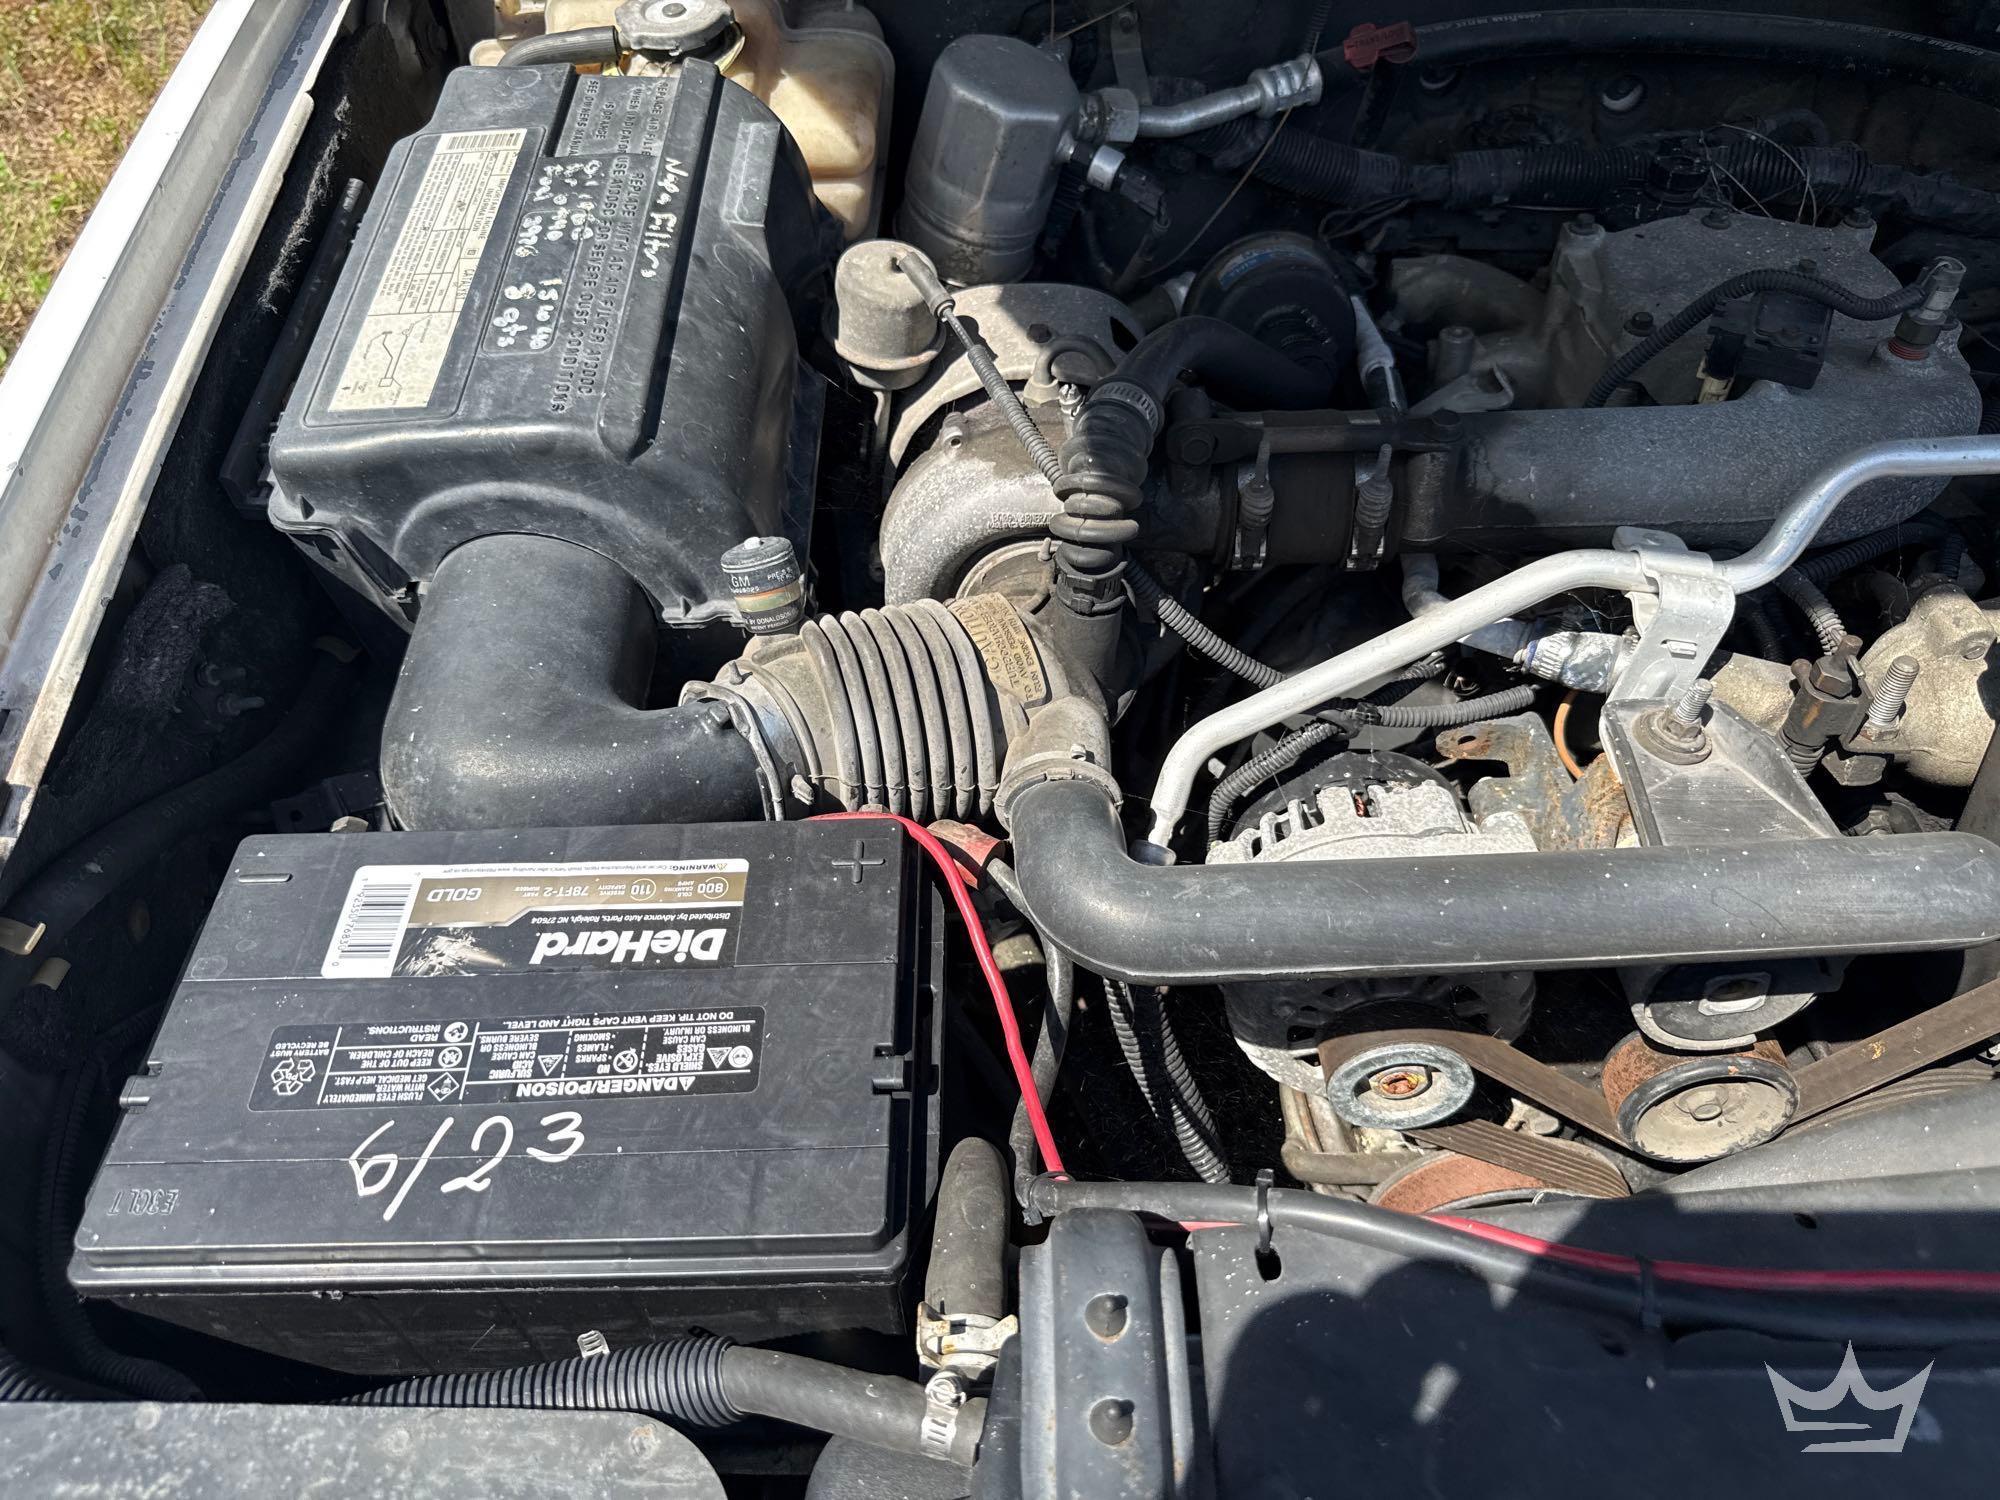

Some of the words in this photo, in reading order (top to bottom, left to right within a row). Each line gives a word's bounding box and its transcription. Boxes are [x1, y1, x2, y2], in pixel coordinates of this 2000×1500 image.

[586, 80, 598, 94] SEE
[626, 88, 643, 110] WHEN
[650, 82, 669, 114] REPLACE
[577, 96, 594, 127] OWNERS
[648, 117, 659, 130] AIR
[612, 157, 630, 176] USE
[487, 178, 507, 215] IMPORTANT
[622, 173, 645, 217] REPLACE
[472, 188, 494, 232] INFORMATION
[477, 216, 494, 240] ENGINE
[595, 220, 612, 241] FOR
[612, 221, 634, 252] WITH
[583, 244, 606, 287] SEVERE
[455, 268, 475, 301] CATALYST
[603, 278, 620, 295] AIR
[571, 294, 594, 325] DUST
[590, 301, 614, 344] FILTER
[549, 331, 585, 412] CONDITIONS
[731, 575, 751, 587] GM
[953, 604, 1000, 670] CAUTION
[1017, 636, 1035, 666] ENGINE
[1013, 652, 1028, 679] AVOID
[1030, 670, 1042, 693] RUN
[1024, 685, 1033, 701] TO
[543, 886, 590, 896] 78FT-2
[630, 885, 651, 895] 110
[697, 883, 723, 894] 800
[426, 887, 482, 902] GOLD
[349, 892, 365, 919] 92350
[558, 916, 569, 924] NC
[570, 914, 600, 922] Raleigh,
[601, 914, 623, 922] Parts,
[624, 914, 642, 922] Auto
[644, 914, 676, 922] Advance
[677, 912, 688, 920] by:
[689, 912, 730, 920] Distributed
[338, 922, 355, 950] 76830
[529, 928, 727, 964] DieHard
[593, 1016, 620, 1026] CAPS
[621, 1015, 647, 1024] VENT
[649, 1014, 676, 1023] KEEP
[678, 1013, 694, 1022] TIP.
[696, 1012, 720, 1021] NOT
[721, 1012, 733, 1020] DO
[503, 1020, 537, 1029] LEVEL.
[539, 1019, 560, 1028] AND
[561, 1018, 591, 1027] TIGHT
[367, 1024, 441, 1035] INSTRUCTIONS.
[663, 1027, 693, 1036] INJURY.
[694, 1026, 706, 1034] OR
[707, 1024, 750, 1034] BLINDNESS
[410, 1034, 439, 1042] READ
[478, 1035, 508, 1044] BURNS.
[510, 1034, 539, 1043] SEVERE
[573, 1032, 611, 1042] SMOKING
[662, 1035, 689, 1044] CAUSE
[690, 1034, 707, 1043] CAN
[275, 1042, 318, 1050] RECYCLED
[480, 1044, 492, 1053] OR
[494, 1043, 538, 1052] BLINDNESS
[576, 1043, 609, 1052] FLAMES
[676, 1044, 705, 1052] GASES
[349, 1050, 393, 1060] CHILDREN.
[395, 1050, 405, 1058] OF
[407, 1049, 434, 1058] REACH
[490, 1051, 517, 1061] CAUSE
[518, 1051, 536, 1060] CAN
[576, 1054, 607, 1063] SPARKS
[655, 1052, 704, 1062] EXPLOSIVE
[361, 1060, 378, 1068] THE
[380, 1059, 390, 1068] OF
[392, 1059, 409, 1067] OUT
[411, 1058, 432, 1067] KEEP
[513, 1060, 535, 1070] ACID
[645, 1062, 671, 1072] EYES.
[672, 1062, 703, 1071] SHIELD
[488, 1069, 533, 1079] SULFURIC
[596, 1064, 610, 1074] NO
[335, 1076, 354, 1085] FAST.
[356, 1075, 377, 1084] HELP
[378, 1074, 411, 1083] MEDICAL
[413, 1074, 428, 1082] GET
[375, 1084, 404, 1093] WATER.
[406, 1084, 425, 1092] WITH
[516, 1077, 679, 1097] DANGER/POISON
[322, 1093, 376, 1103] IMMEDIATELY
[377, 1092, 396, 1101] EYES
[397, 1092, 423, 1100] FLUSH
[347, 1111, 585, 1221] 6/23
